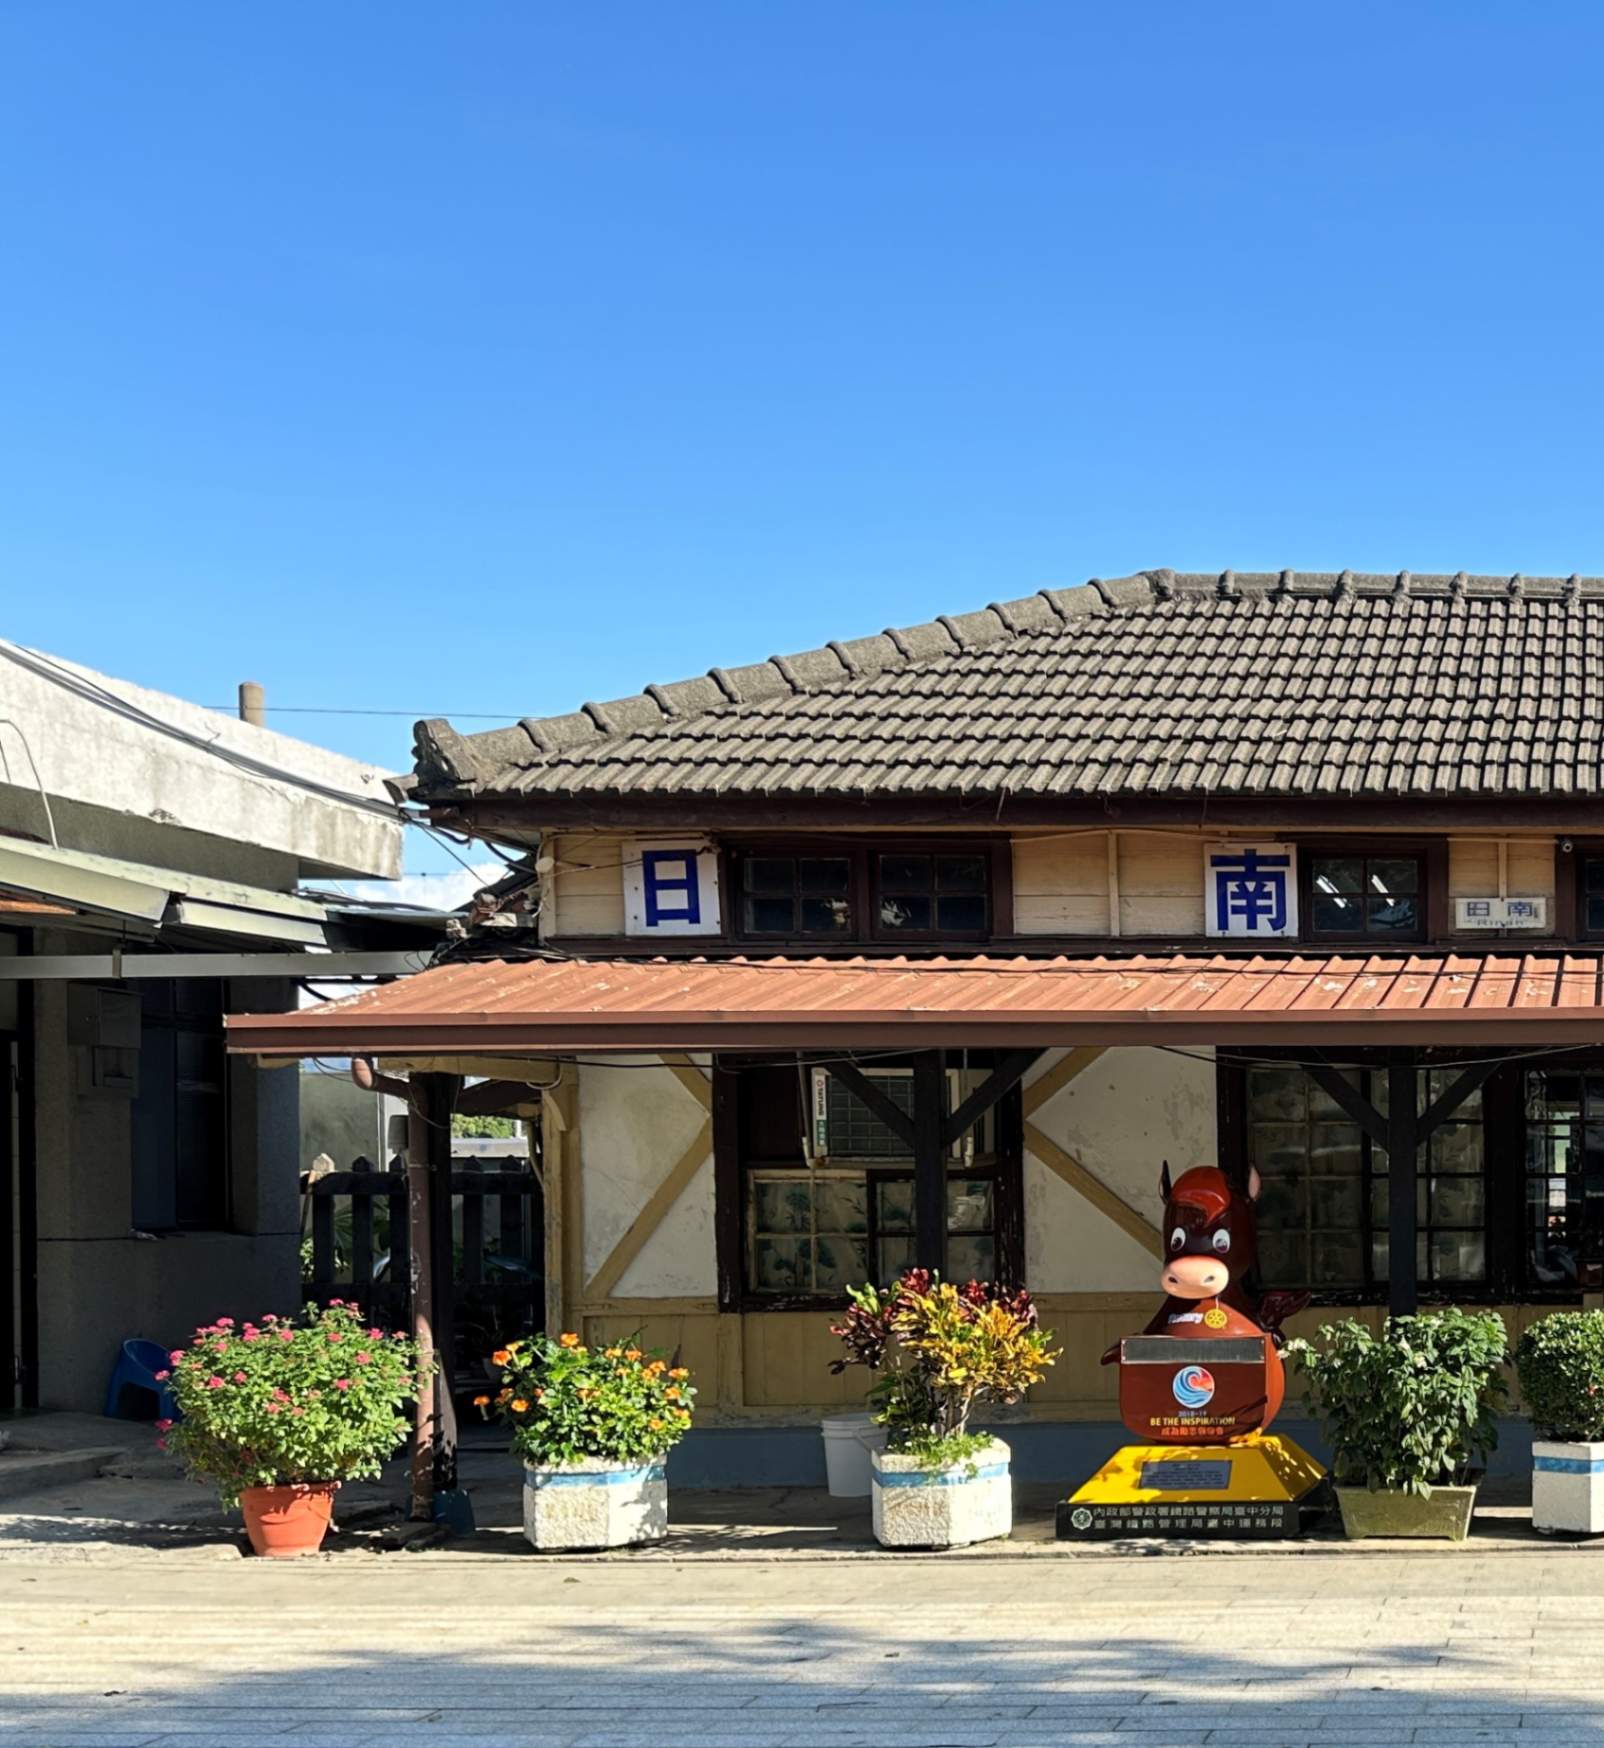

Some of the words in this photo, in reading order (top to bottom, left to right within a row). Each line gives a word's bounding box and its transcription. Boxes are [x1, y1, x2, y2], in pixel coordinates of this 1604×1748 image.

[643, 849, 701, 927] 日
[1210, 849, 1290, 931] 南
[1150, 1417, 1161, 1426] BE
[1163, 1417, 1179, 1425] THE
[1181, 1416, 1235, 1425] INSPIRATION
